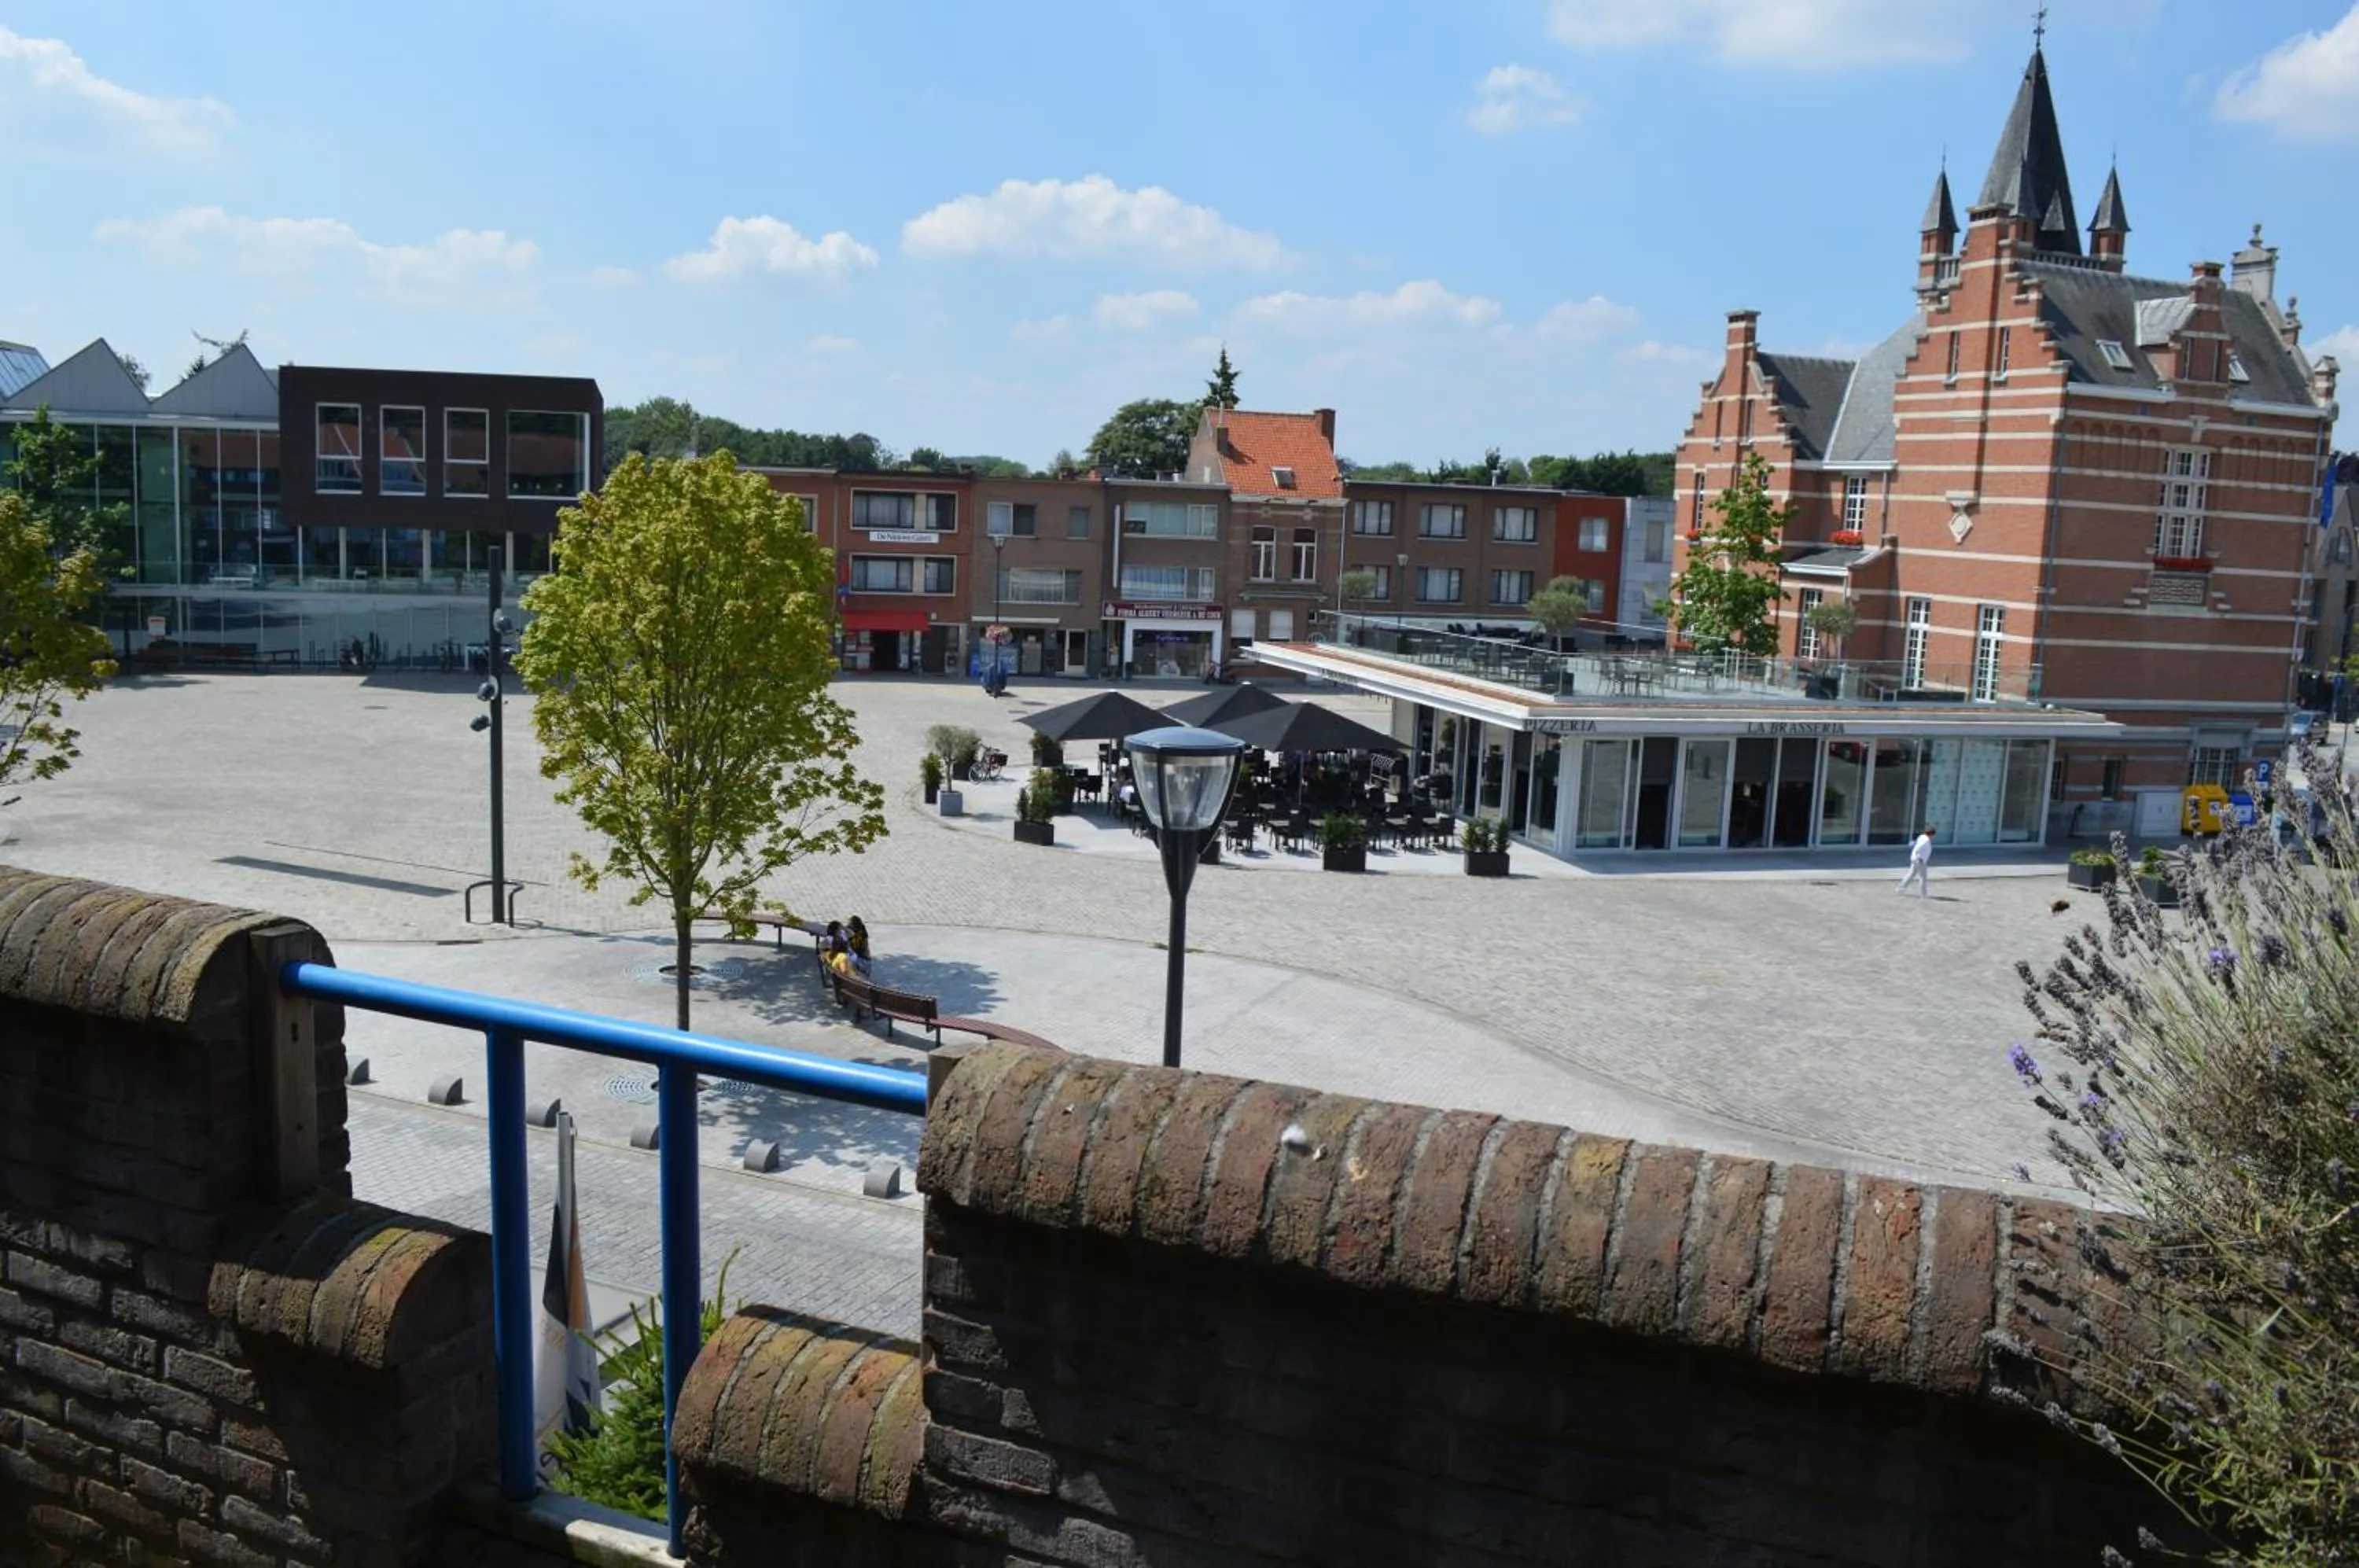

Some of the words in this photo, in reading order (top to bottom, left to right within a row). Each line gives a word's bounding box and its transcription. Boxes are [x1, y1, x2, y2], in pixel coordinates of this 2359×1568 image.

[1524, 719, 1598, 732] PIZZERIA
[1747, 722, 1766, 734] LA
[1770, 722, 1846, 734] BRASSERIA
